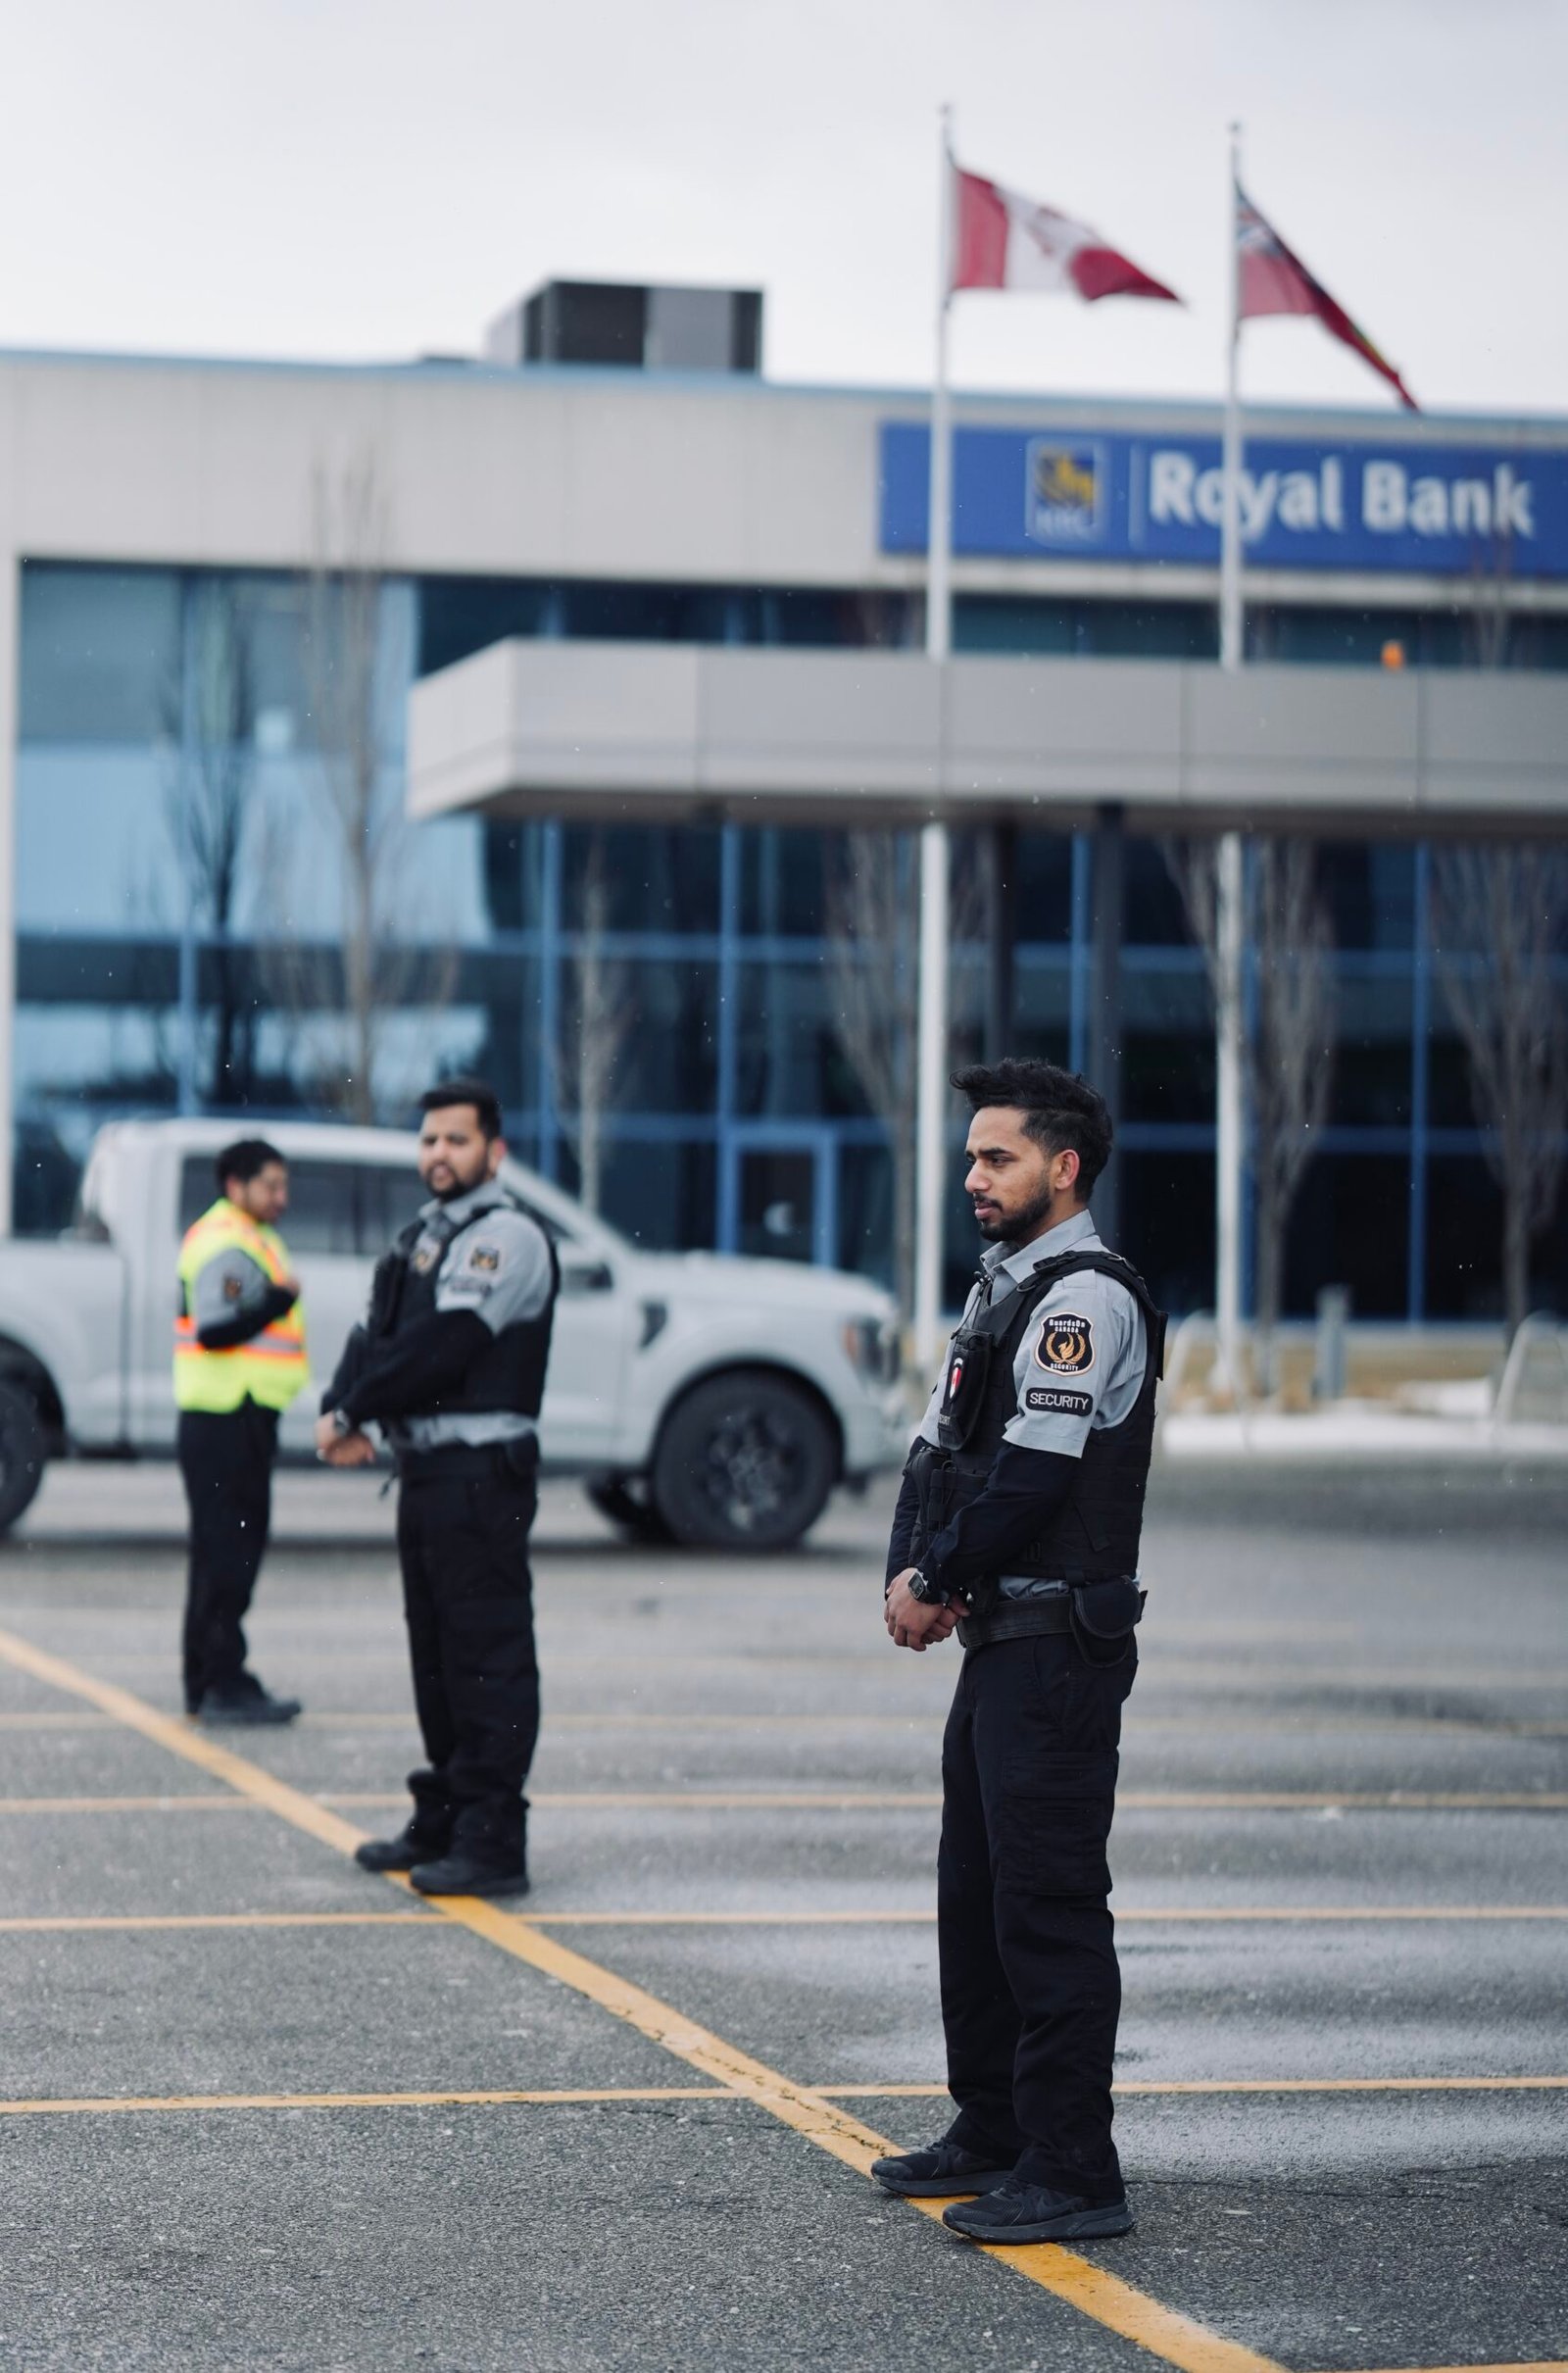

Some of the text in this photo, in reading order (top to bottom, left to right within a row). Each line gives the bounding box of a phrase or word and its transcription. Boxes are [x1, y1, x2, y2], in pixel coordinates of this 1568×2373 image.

[1151, 451, 1535, 545] Royal Bank
[1049, 1318, 1086, 1328] GuardsOn
[1050, 1362, 1079, 1371] SECURITY
[1029, 1392, 1089, 1410] SECURITY
